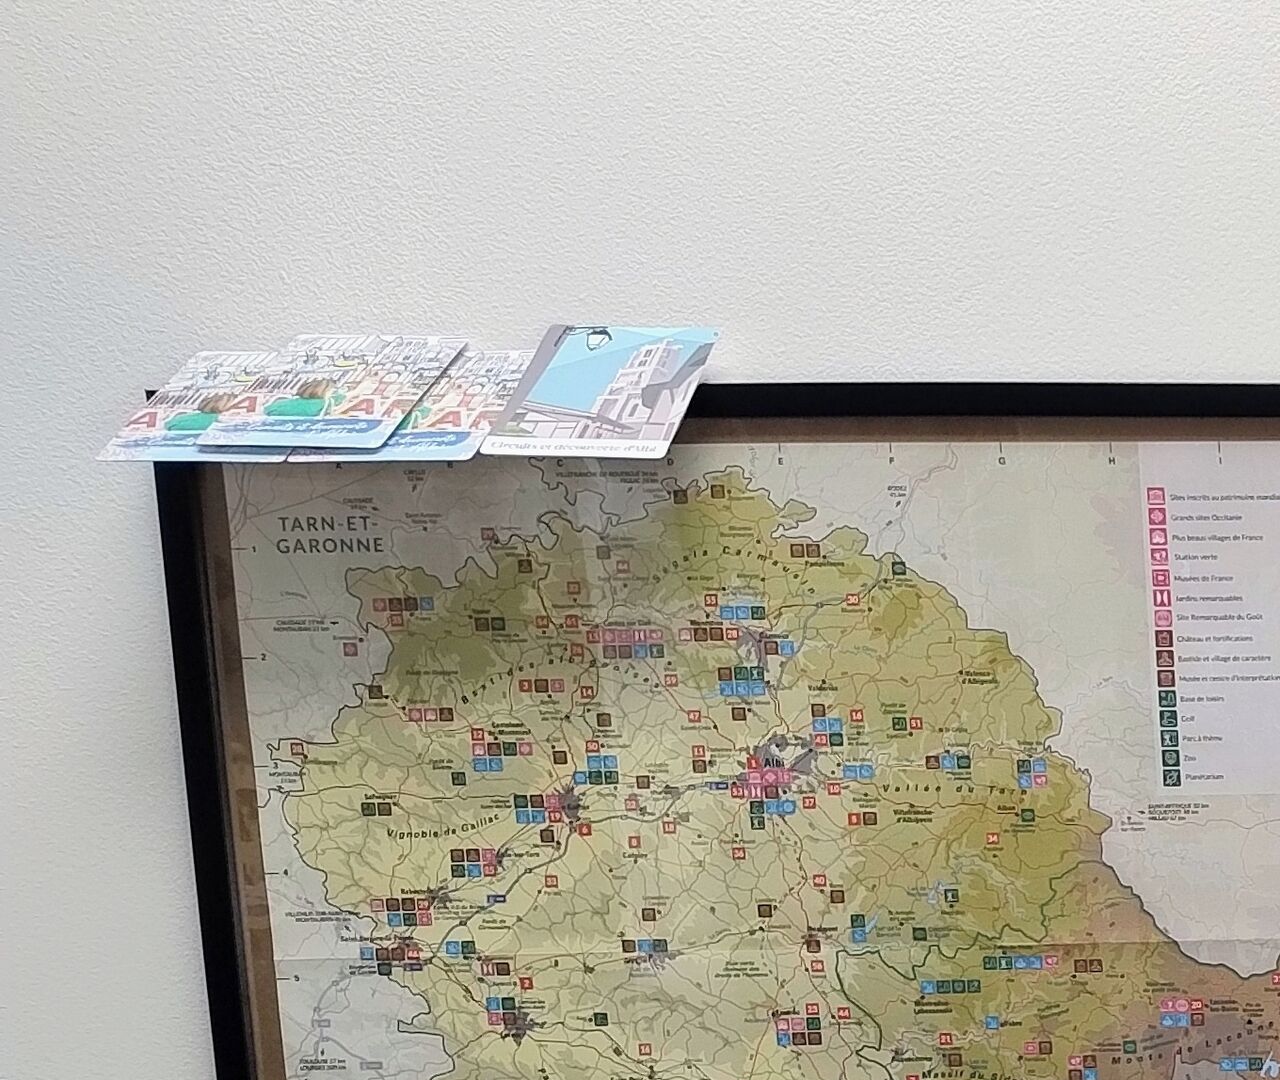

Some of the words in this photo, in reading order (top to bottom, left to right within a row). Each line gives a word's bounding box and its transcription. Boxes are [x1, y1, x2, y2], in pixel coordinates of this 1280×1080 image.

[280, 515, 379, 532] TARN-ET-
[276, 537, 385, 554] GARONNE
[764, 757, 785, 768] Albi
[882, 783, 941, 793] Vallée
[956, 784, 975, 793] du
[989, 786, 1028, 796] Tarn
[386, 826, 439, 841] Vignoble
[444, 827, 457, 836] de
[461, 813, 500, 833] Gaillac
[1111, 1053, 1163, 1065] Monts
[922, 1069, 965, 1080] Massif
[970, 1069, 986, 1080] du
